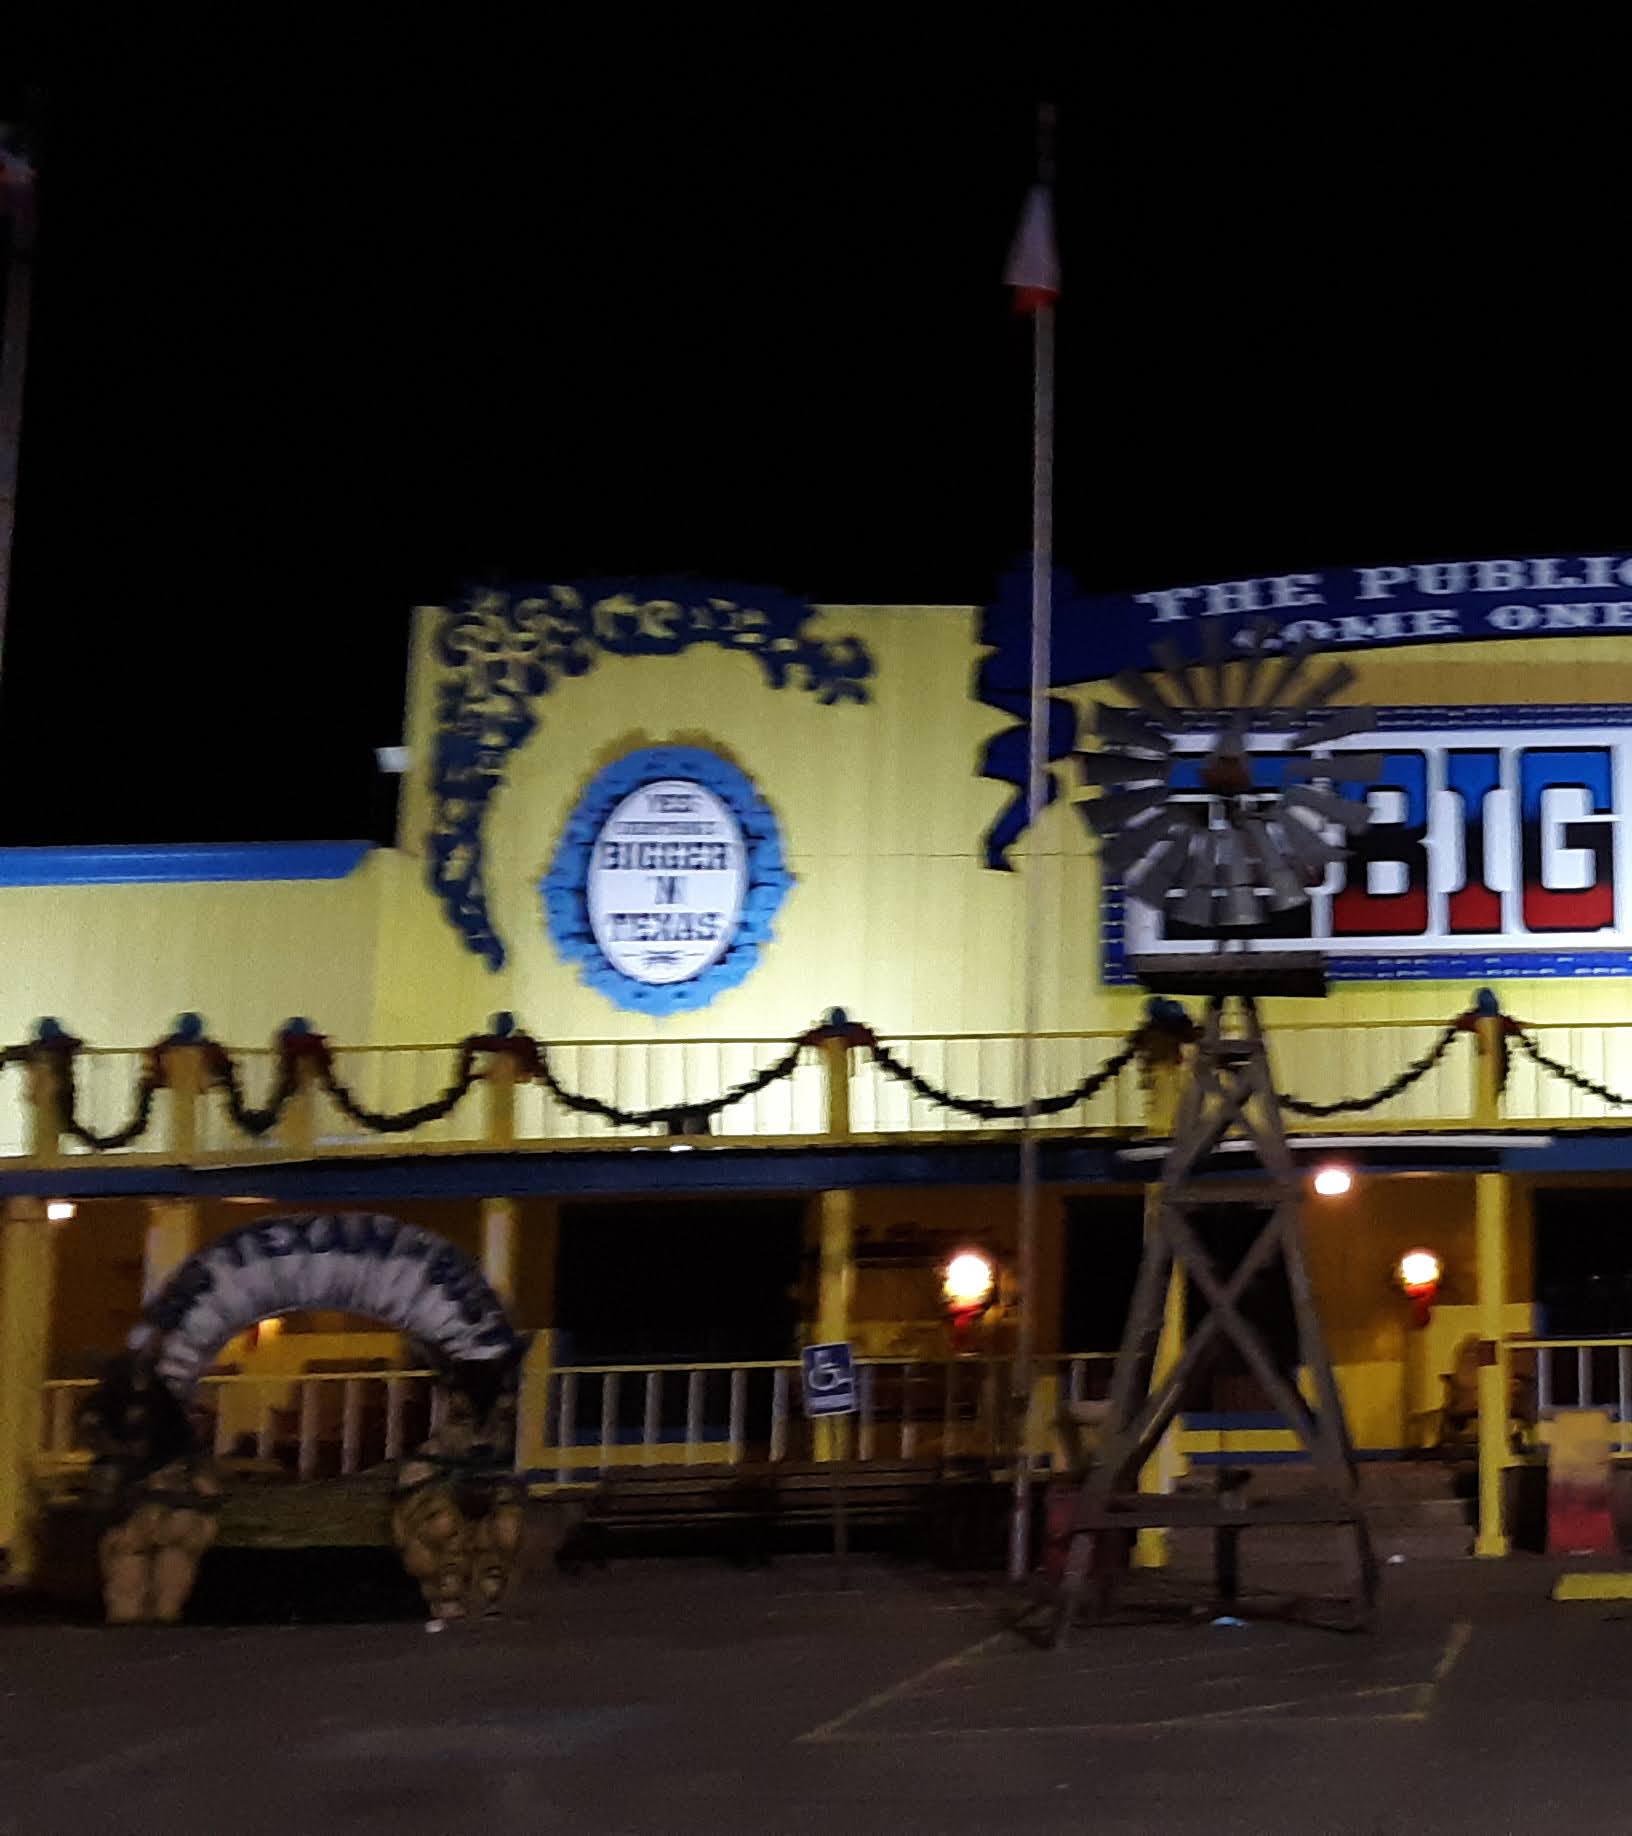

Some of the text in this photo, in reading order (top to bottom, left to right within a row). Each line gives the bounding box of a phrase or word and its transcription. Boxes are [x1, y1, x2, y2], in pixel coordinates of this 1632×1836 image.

[1134, 573, 1326, 622] THE
[601, 841, 730, 870] BIGGER
[1328, 749, 1614, 935] BIG
[607, 912, 724, 943] TEXAS
